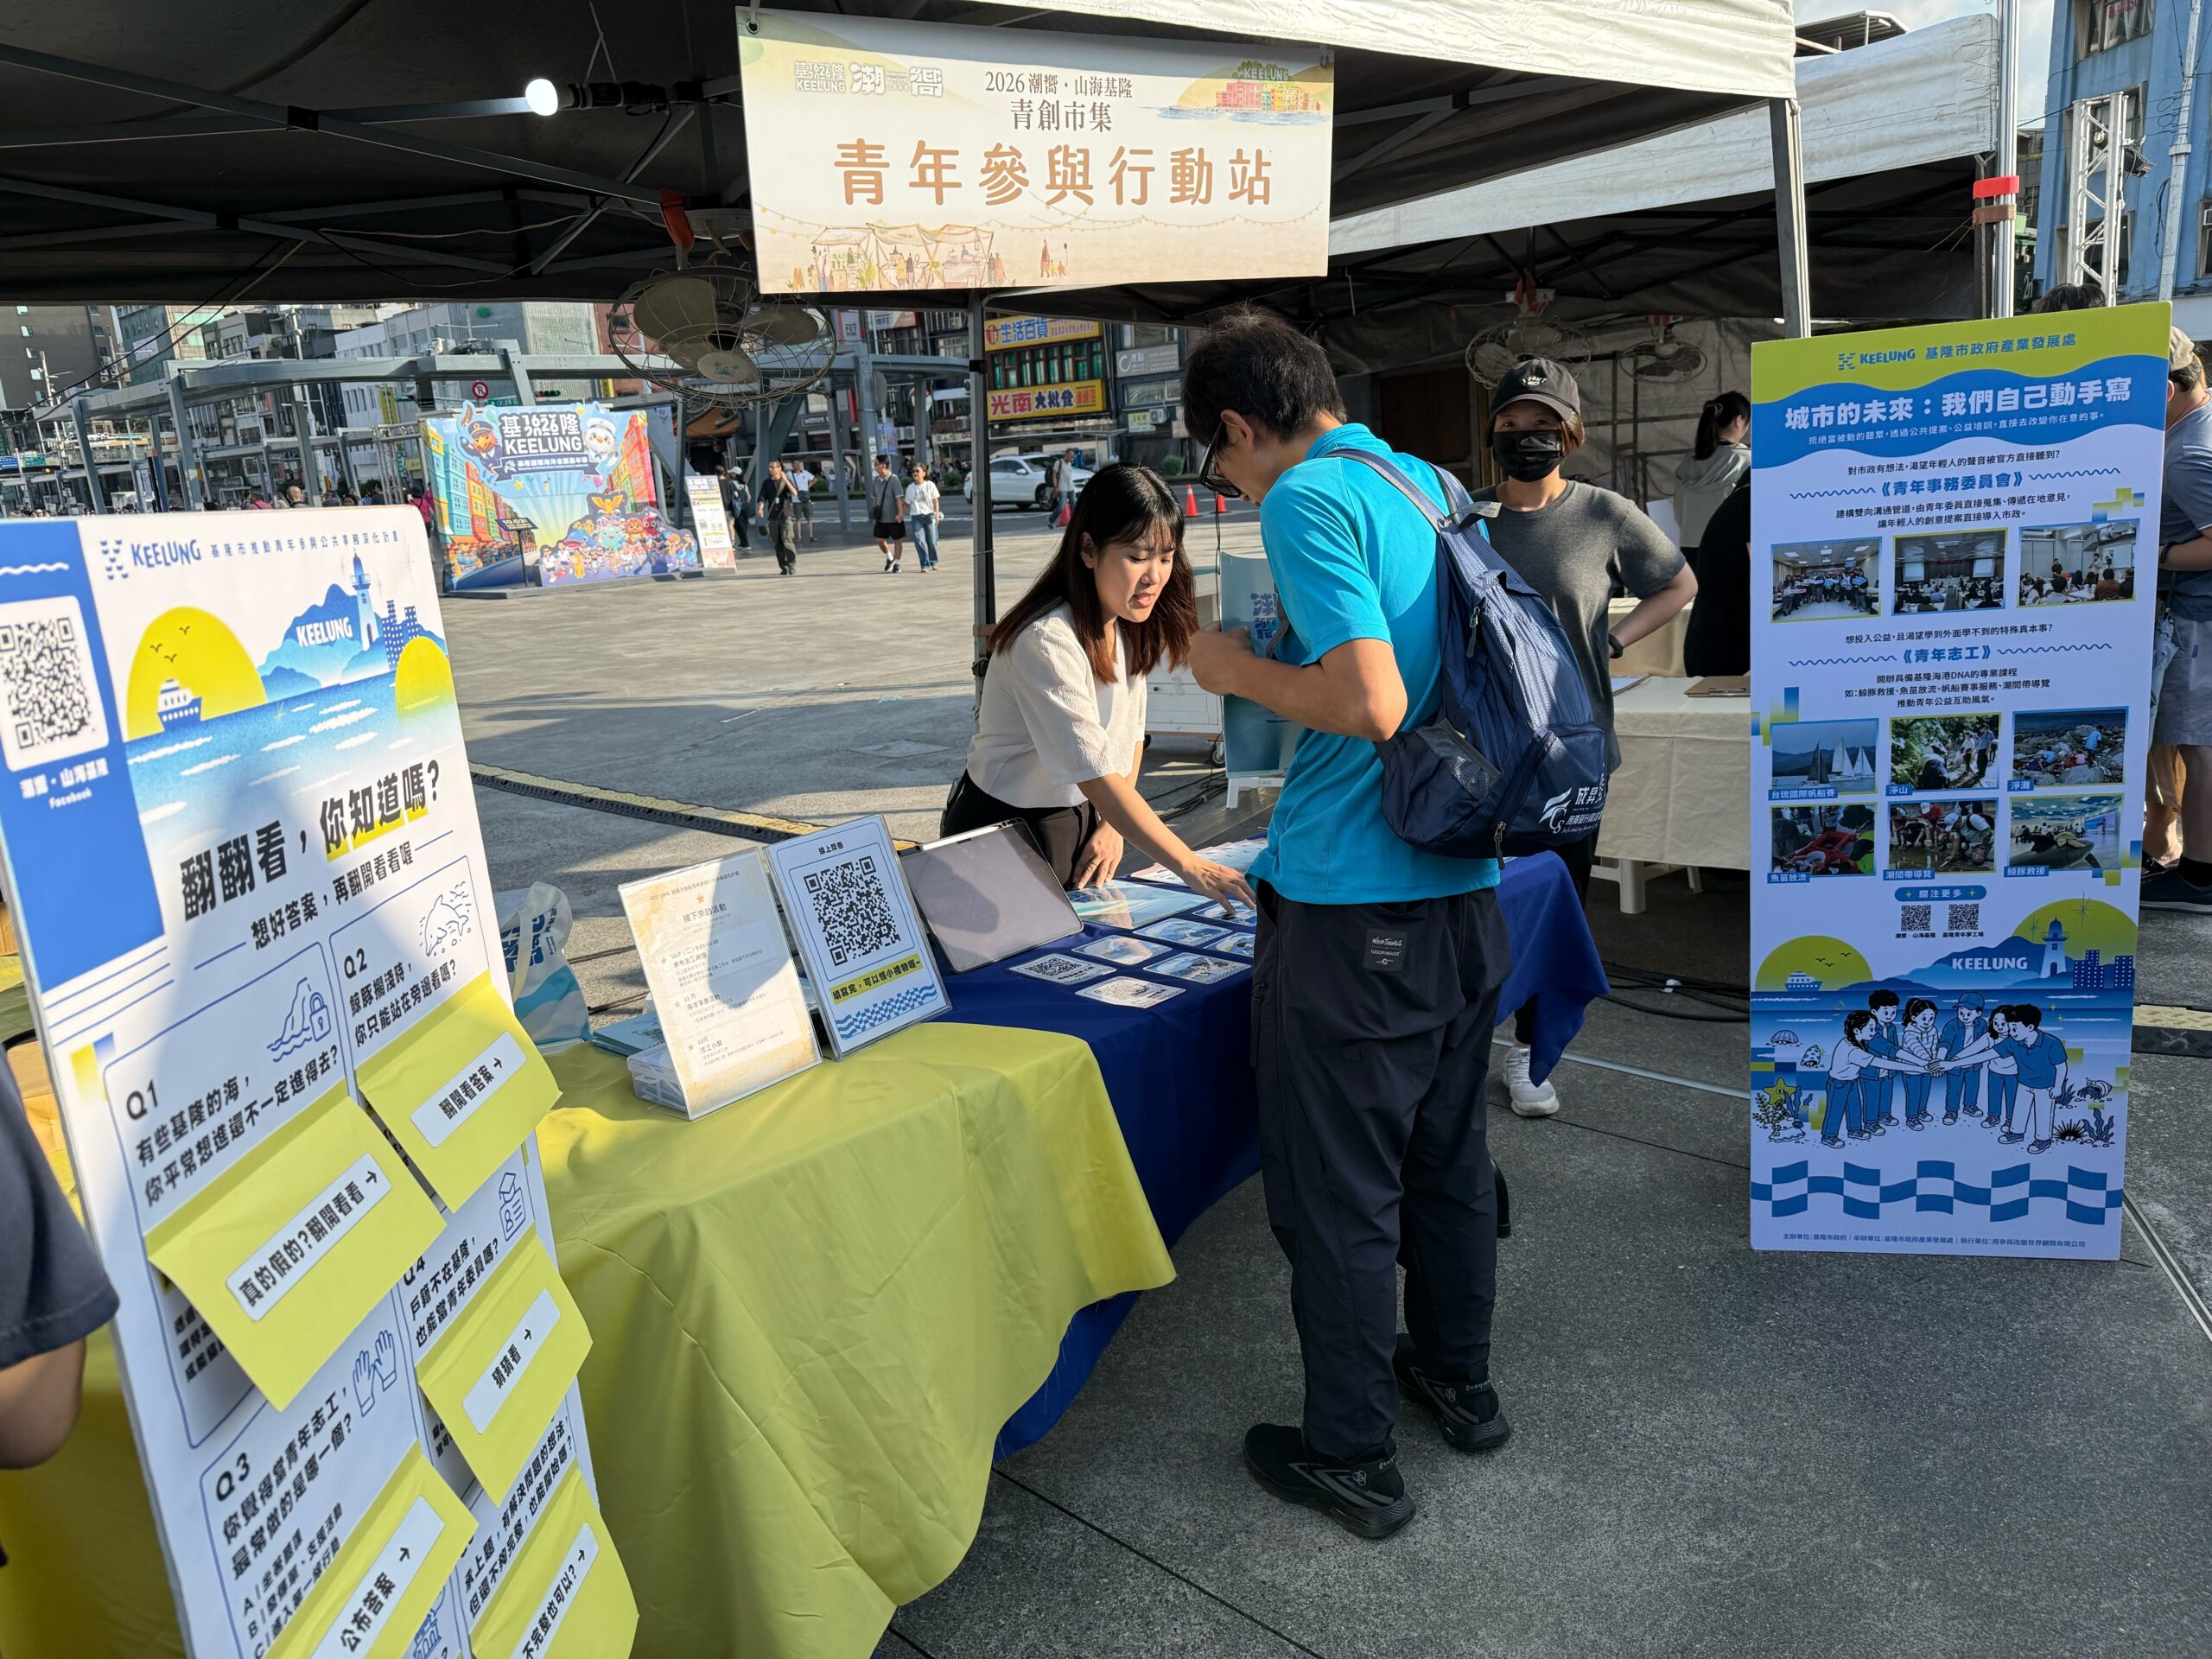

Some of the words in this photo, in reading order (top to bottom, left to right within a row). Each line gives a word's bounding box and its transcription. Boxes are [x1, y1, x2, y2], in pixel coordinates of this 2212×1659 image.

[796, 79, 845, 92] KEELUNG
[985, 71, 1025, 93] 2026
[1243, 67, 1289, 81] KEELUNG
[1010, 99, 1112, 133] 青創市集
[833, 137, 1272, 207] 青年參與行動站
[1001, 318, 1049, 344] 生活百貨
[1859, 348, 1916, 365] KEELUNG
[1925, 333, 2076, 360] 基隆市政府產業發展處
[990, 392, 1033, 416] 光南
[1034, 389, 1074, 410] 大批發
[1785, 377, 2132, 430] 城市的未來：我們自己動手寫
[505, 436, 582, 454] KEELUNG
[1847, 449, 2060, 476] 對市政有想法，渴望年輕人的聲音被官方直接聽到？
[1881, 471, 2024, 497] 《青年事務委員會》
[1878, 510, 2026, 528] 讓年輕人的創意提案直接導入市政。
[130, 539, 201, 568] KEELUNG
[296, 616, 353, 648] KEELUNG
[1845, 623, 2053, 644] 想投入公益，且渴望學到外面學不到的特殊真本事？
[1903, 644, 1991, 664] 《青年志工》
[1877, 668, 2018, 683] 開辦具備基隆海港DNA的專業課程
[1897, 695, 1995, 709] 推動青年公益互助風氣。
[1770, 788, 1835, 800] 台琉國際帆船賽
[1889, 785, 1909, 795] 淨山
[2011, 780, 2031, 791] 淨灘
[180, 760, 440, 922] 翻翻看，你知道嗎？
[1770, 873, 1807, 883] 魚苗放流
[1885, 869, 1933, 880] 潮間帶導覽
[2006, 866, 2046, 876] 鯨豚救援
[250, 841, 414, 950] 想好答案，再翻開看看喔
[1919, 888, 1962, 899] 關注更多
[683, 903, 727, 923] 接下來的活動
[344, 948, 368, 979] Q2
[1952, 956, 2028, 971] KEELUNG
[354, 959, 457, 1047] 你只能站在旁邊看嗎？
[126, 1079, 159, 1121] Q1
[438, 1065, 495, 1120] 翻開看答案
[136, 1076, 250, 1168] 有些基隆的海，
[144, 1045, 339, 1207] 你平常想進還不一定進得去？
[238, 1180, 365, 1307] 真的假的？翻開看看
[416, 1237, 499, 1348] 也能當青年委員嗎？
[491, 1344, 522, 1389] 猜猜看
[216, 1452, 251, 1502] Q3
[222, 1387, 346, 1546] 你覺得當青年志工，
[232, 1412, 352, 1580] 最常做的是哪一個？
[243, 1598, 254, 1618] A
[340, 1572, 396, 1653] 公布答案
[522, 1564, 576, 1659] 不完整也可以？
